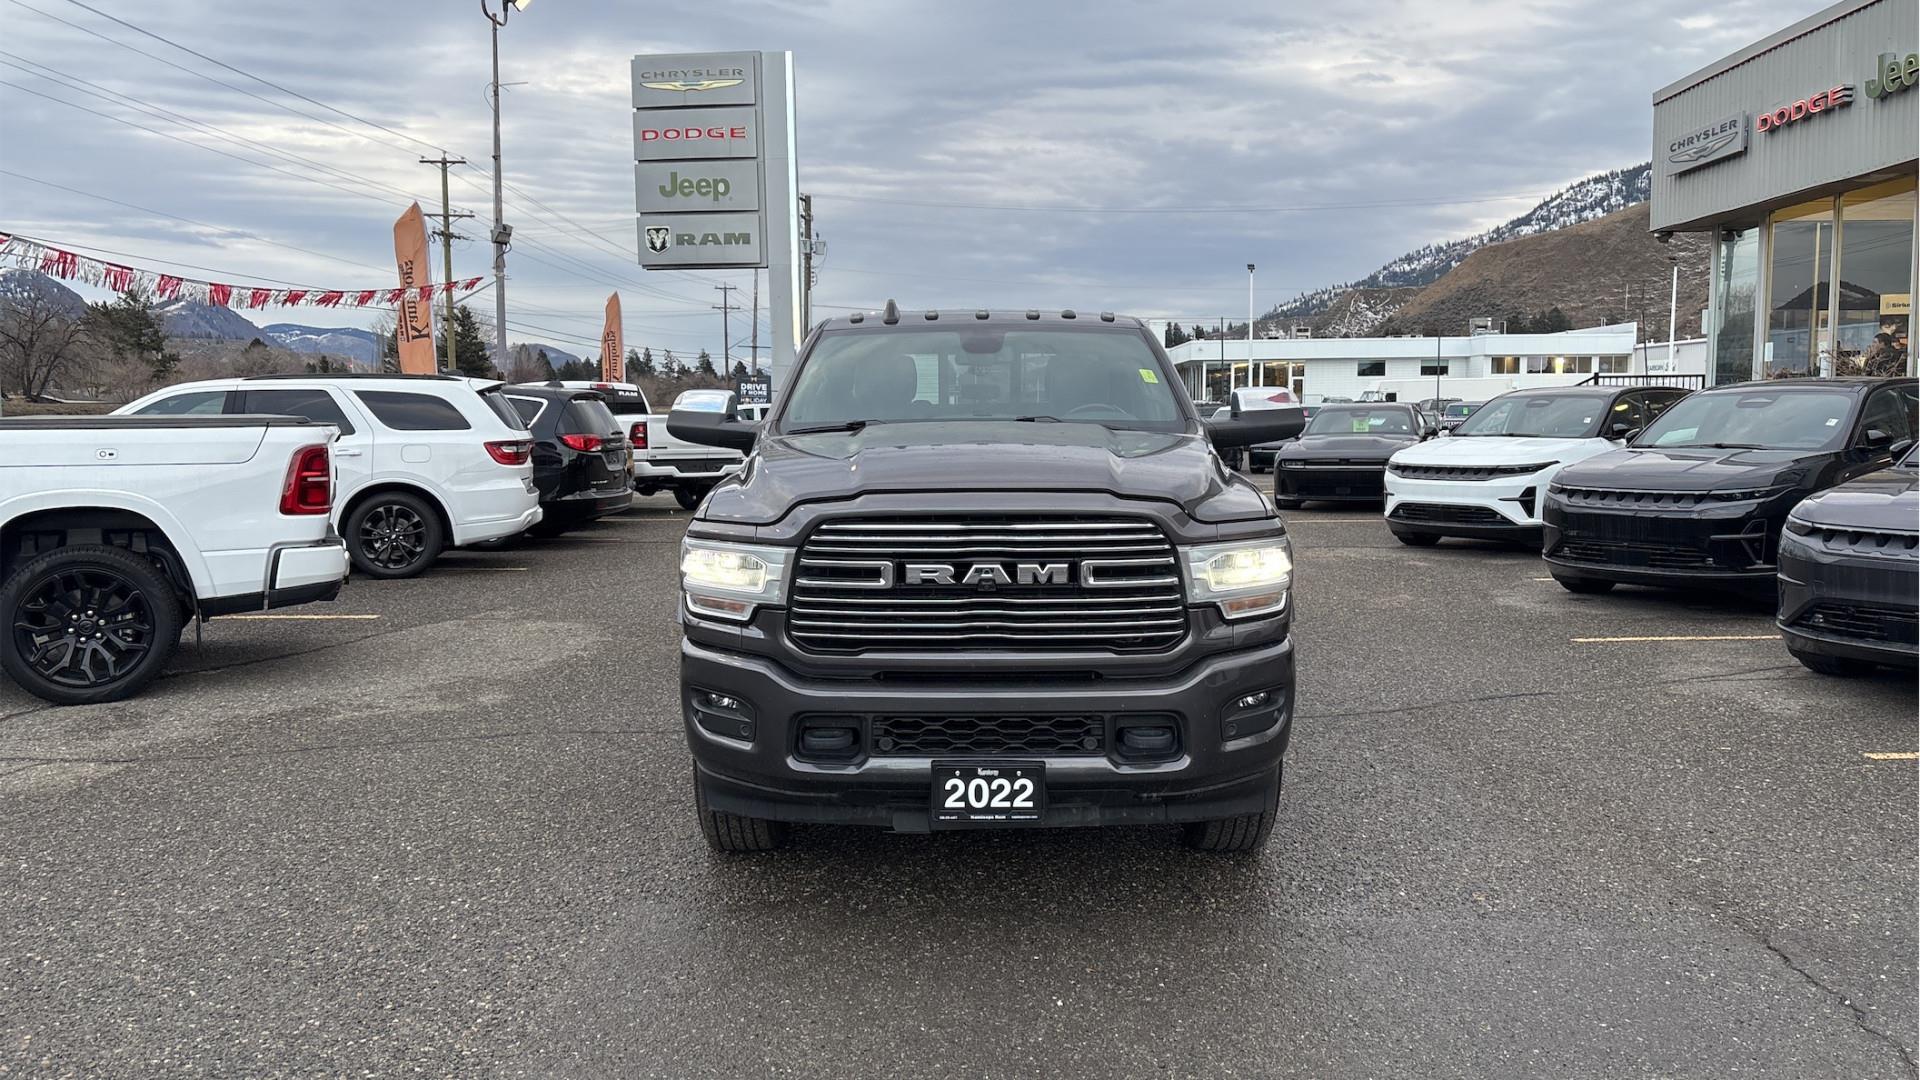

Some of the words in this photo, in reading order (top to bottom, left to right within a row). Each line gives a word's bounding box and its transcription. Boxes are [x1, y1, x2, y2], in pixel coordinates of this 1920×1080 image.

[641, 68, 745, 80] CHRYSLER
[1865, 52, 1919, 99] Jee
[1757, 83, 1854, 133] DODGE
[641, 126, 746, 142] DODGE
[1669, 119, 1738, 153] CHRYSLER
[658, 171, 731, 201] Jeep
[675, 232, 752, 246] RAM
[740, 383, 767, 391] DRIVE
[905, 563, 1069, 585] RAM
[944, 778, 1034, 808] 2022
